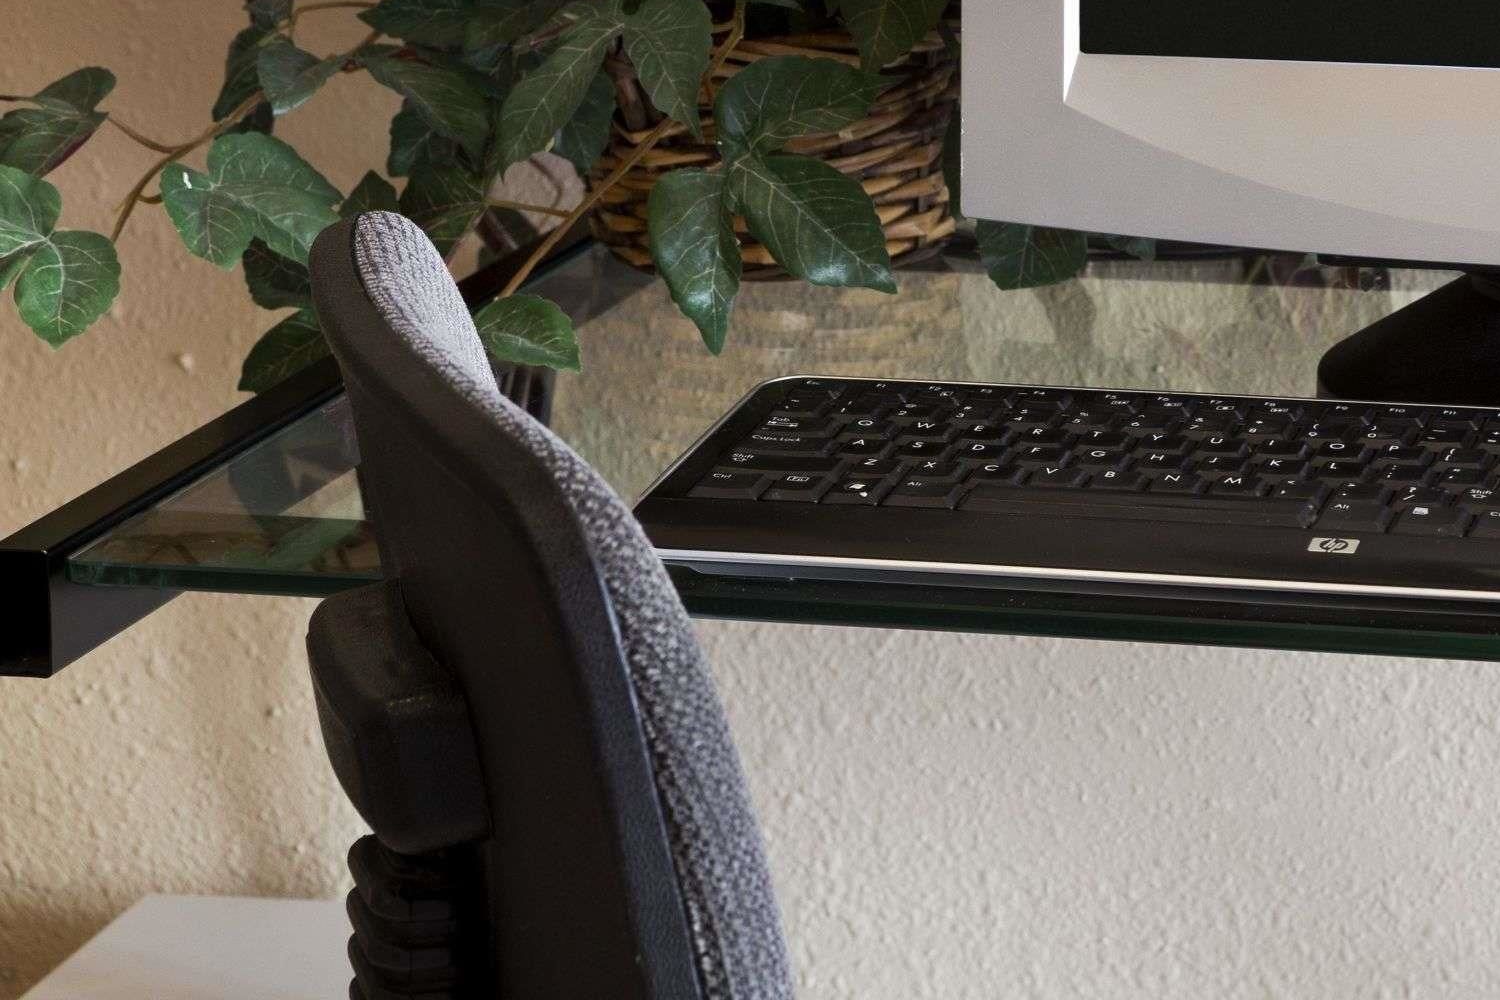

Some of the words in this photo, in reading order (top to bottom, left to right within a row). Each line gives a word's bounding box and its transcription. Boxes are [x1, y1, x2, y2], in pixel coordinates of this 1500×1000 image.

[864, 458, 878, 466] Z
[1270, 458, 1284, 466] K
[1330, 462, 1337, 470] L
